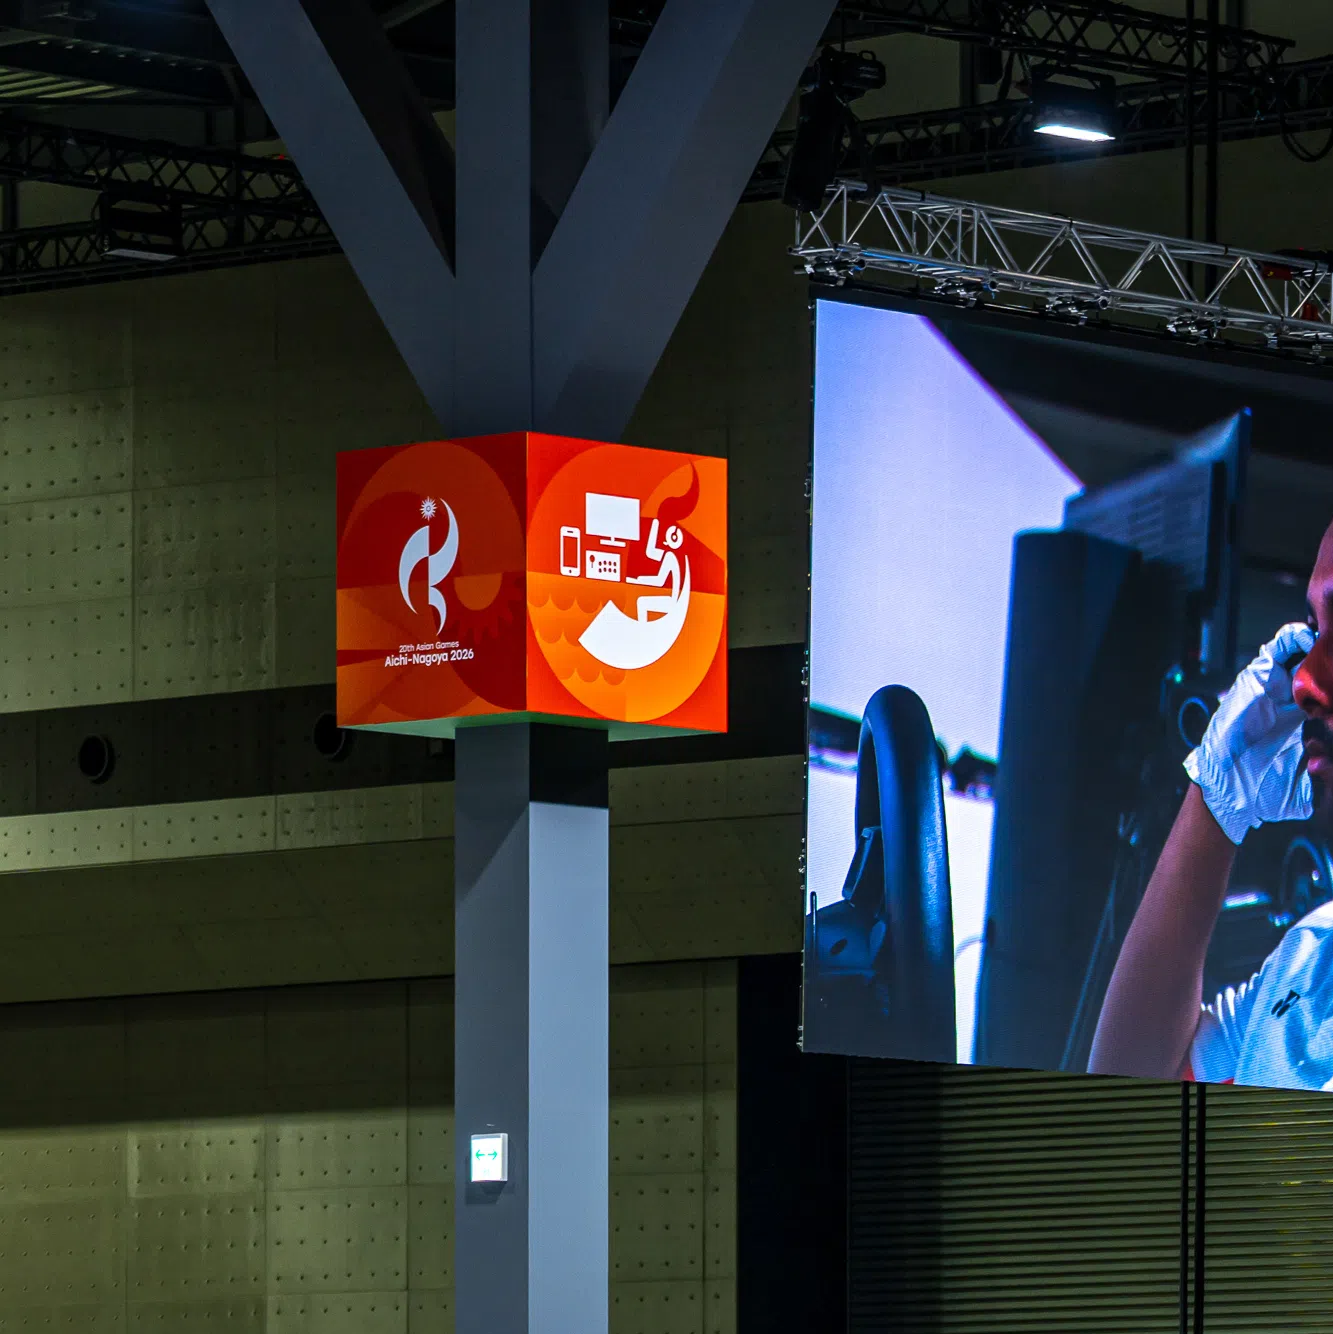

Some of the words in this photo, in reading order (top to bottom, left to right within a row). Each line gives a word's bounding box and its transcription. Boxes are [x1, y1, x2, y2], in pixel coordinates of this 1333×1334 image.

[399, 644, 414, 653] 20th
[416, 642, 434, 651] Asian
[435, 641, 459, 650] Games
[385, 652, 448, 667] Aichi-Nagoya
[450, 649, 474, 661] 2026
